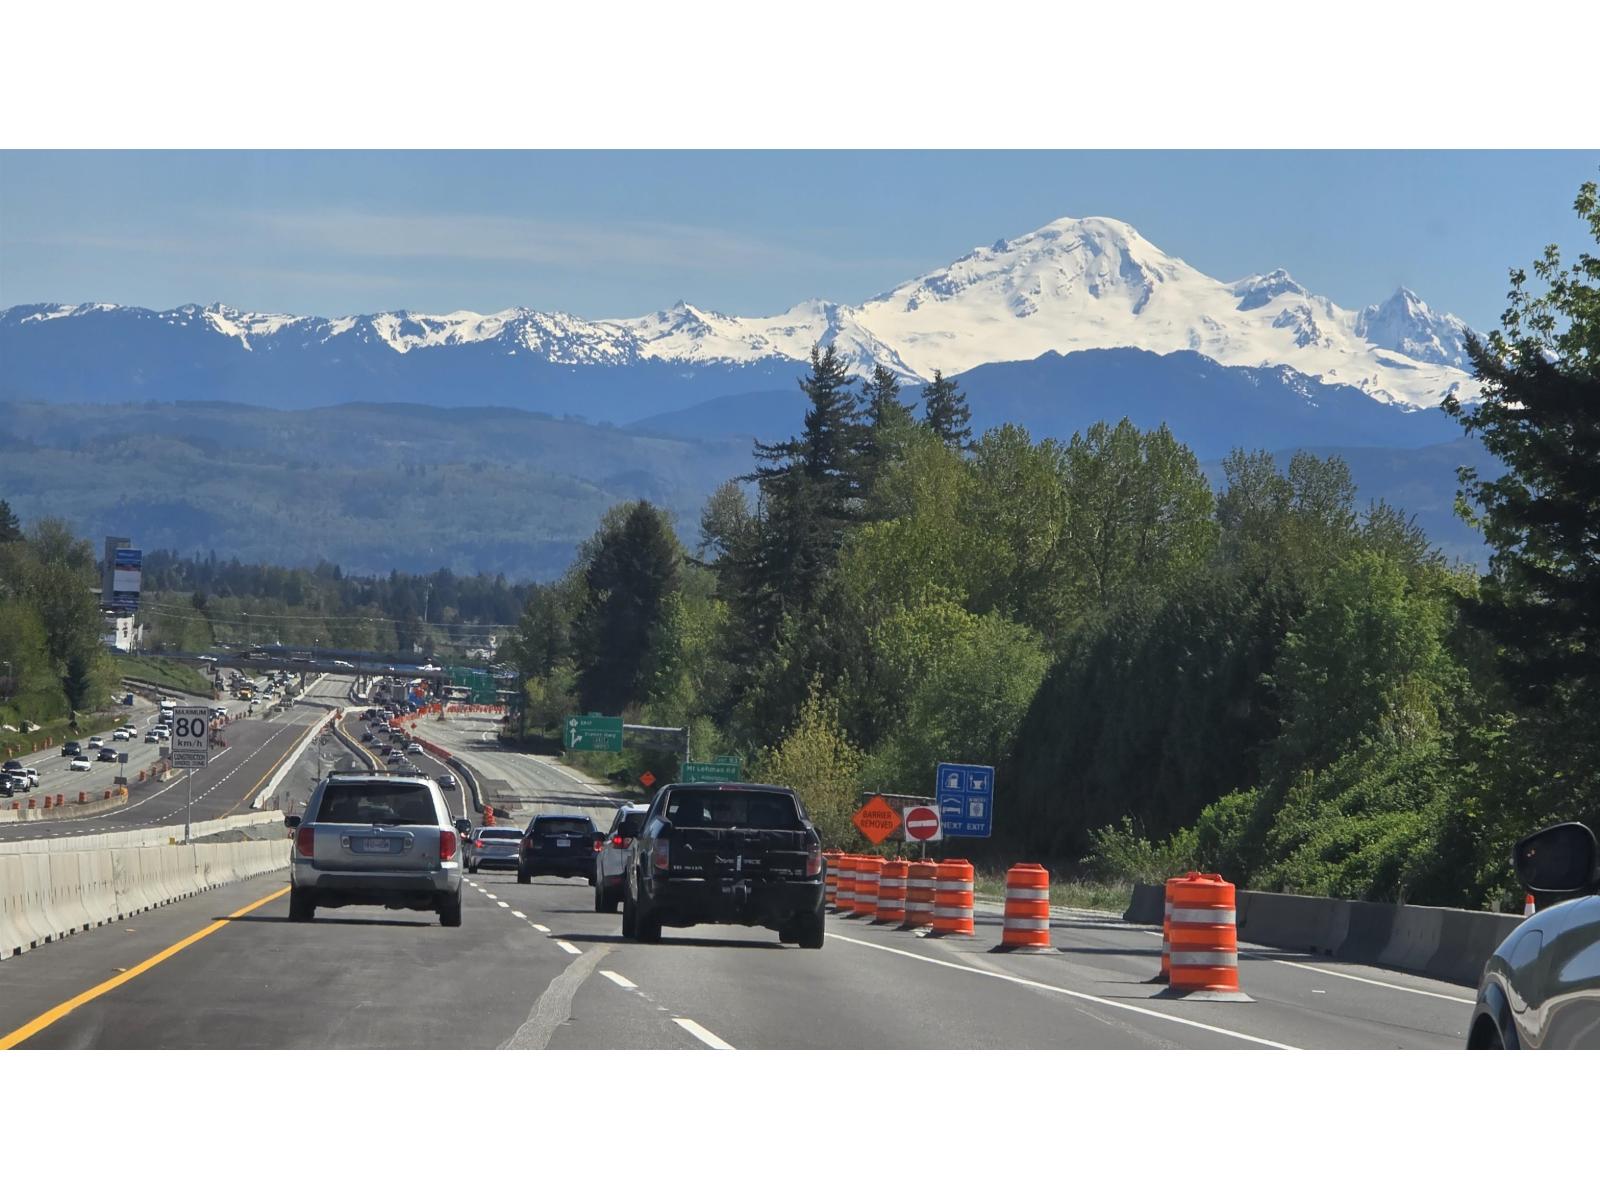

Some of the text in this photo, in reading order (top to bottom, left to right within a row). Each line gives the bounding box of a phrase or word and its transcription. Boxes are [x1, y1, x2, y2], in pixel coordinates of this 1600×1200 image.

[176, 718, 205, 738] 80
[177, 740, 202, 748] km/h
[863, 810, 892, 819] BARRIER
[861, 820, 894, 829] REMOVED
[941, 821, 986, 831] NEXT EXIT
